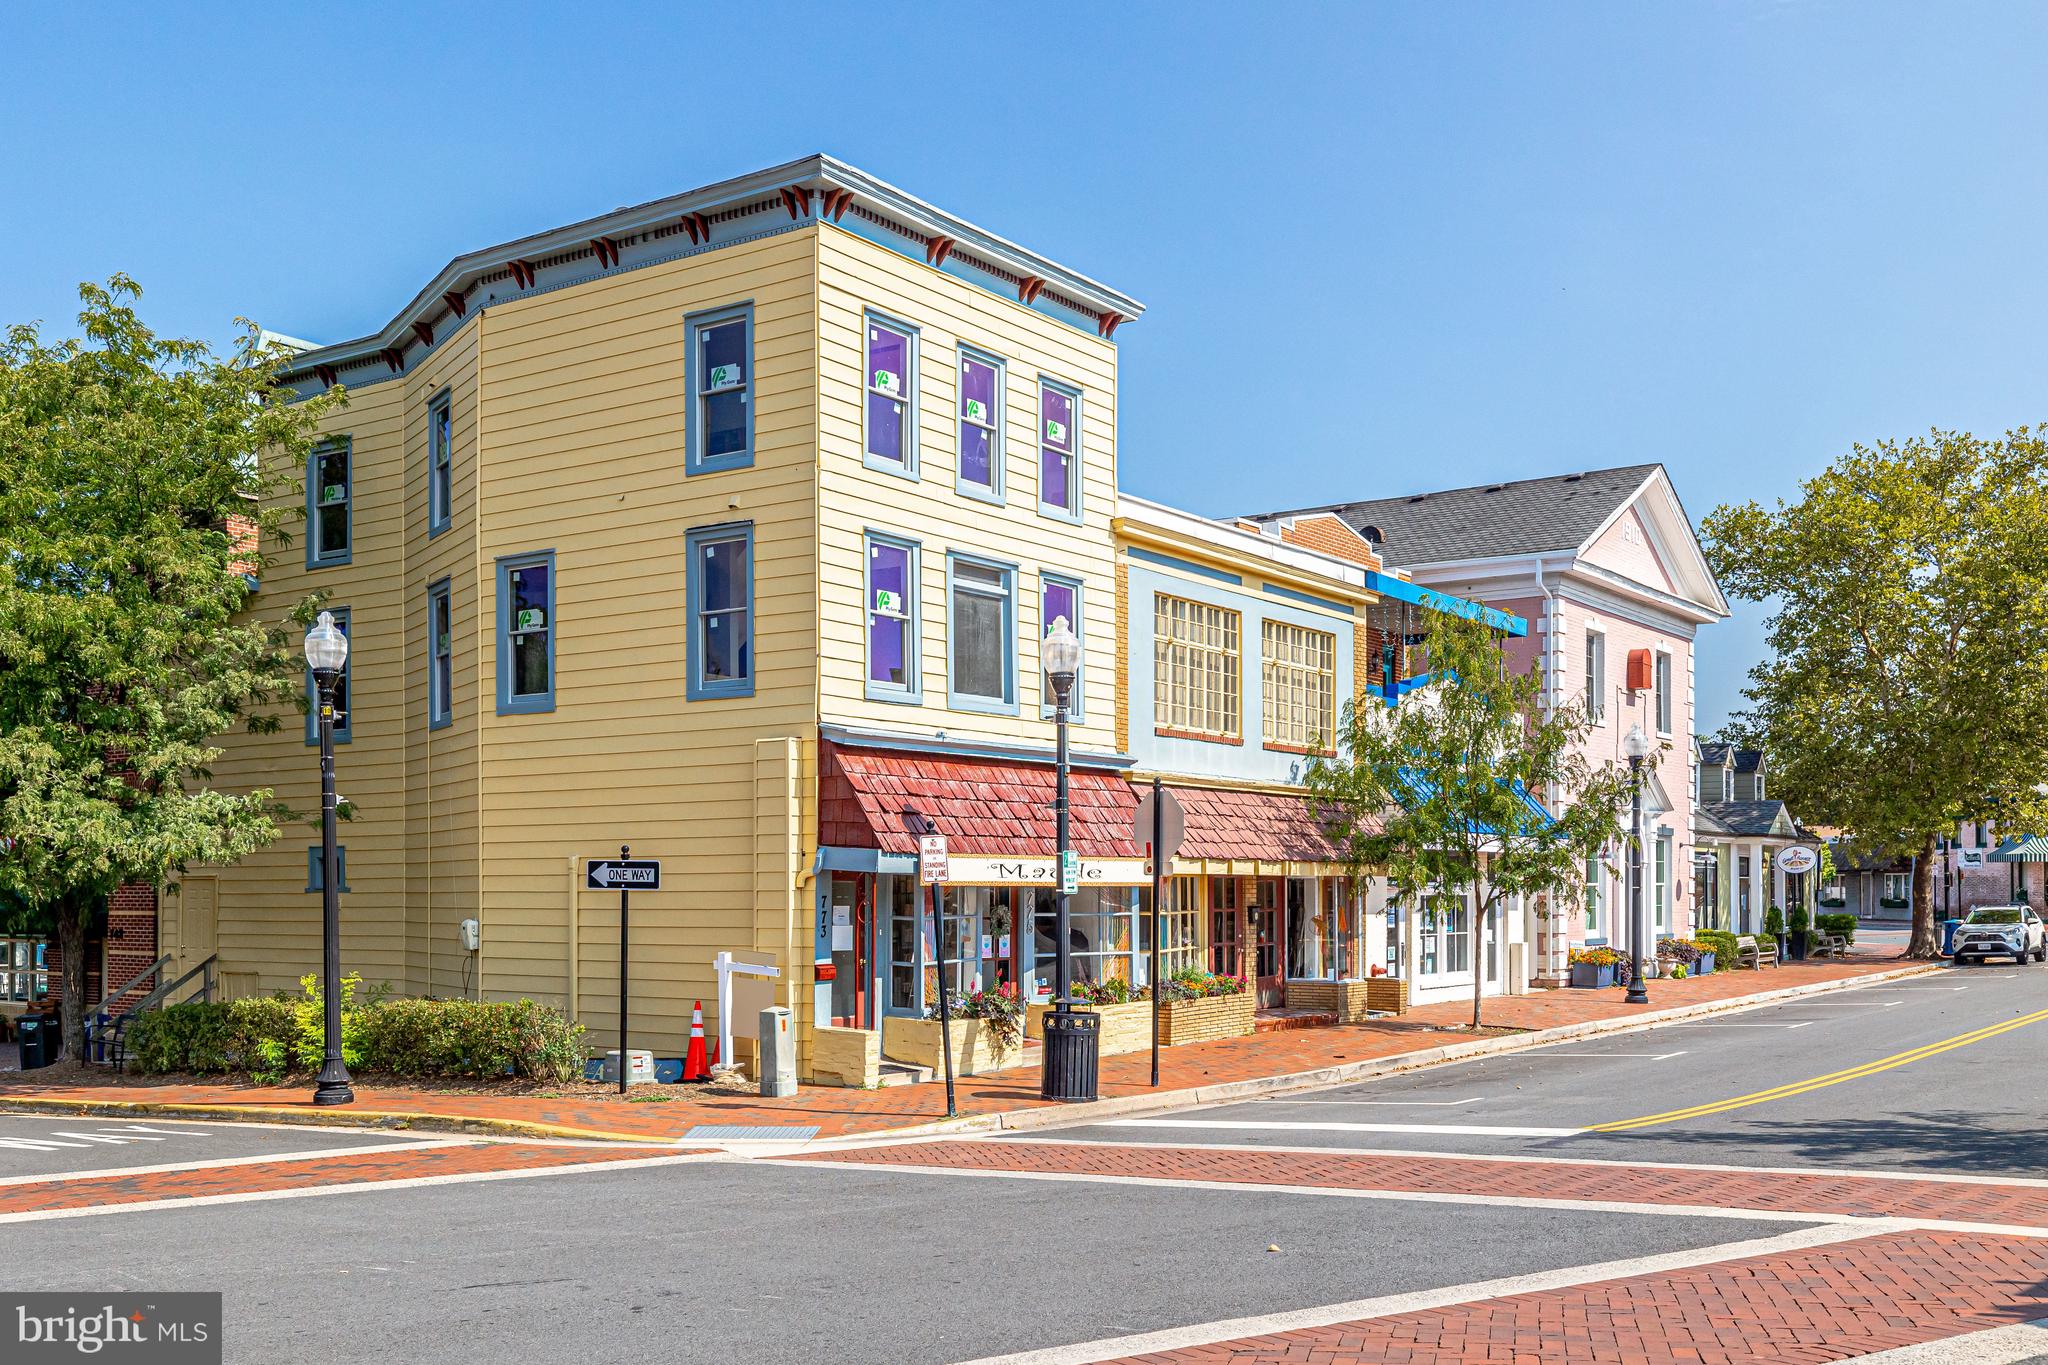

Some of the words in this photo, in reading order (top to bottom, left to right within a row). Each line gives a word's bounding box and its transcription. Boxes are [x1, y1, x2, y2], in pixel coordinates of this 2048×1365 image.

[608, 869, 628, 881] ONE
[631, 869, 652, 881] WAY
[925, 870, 935, 878] FIRE
[935, 869, 947, 878] LANE
